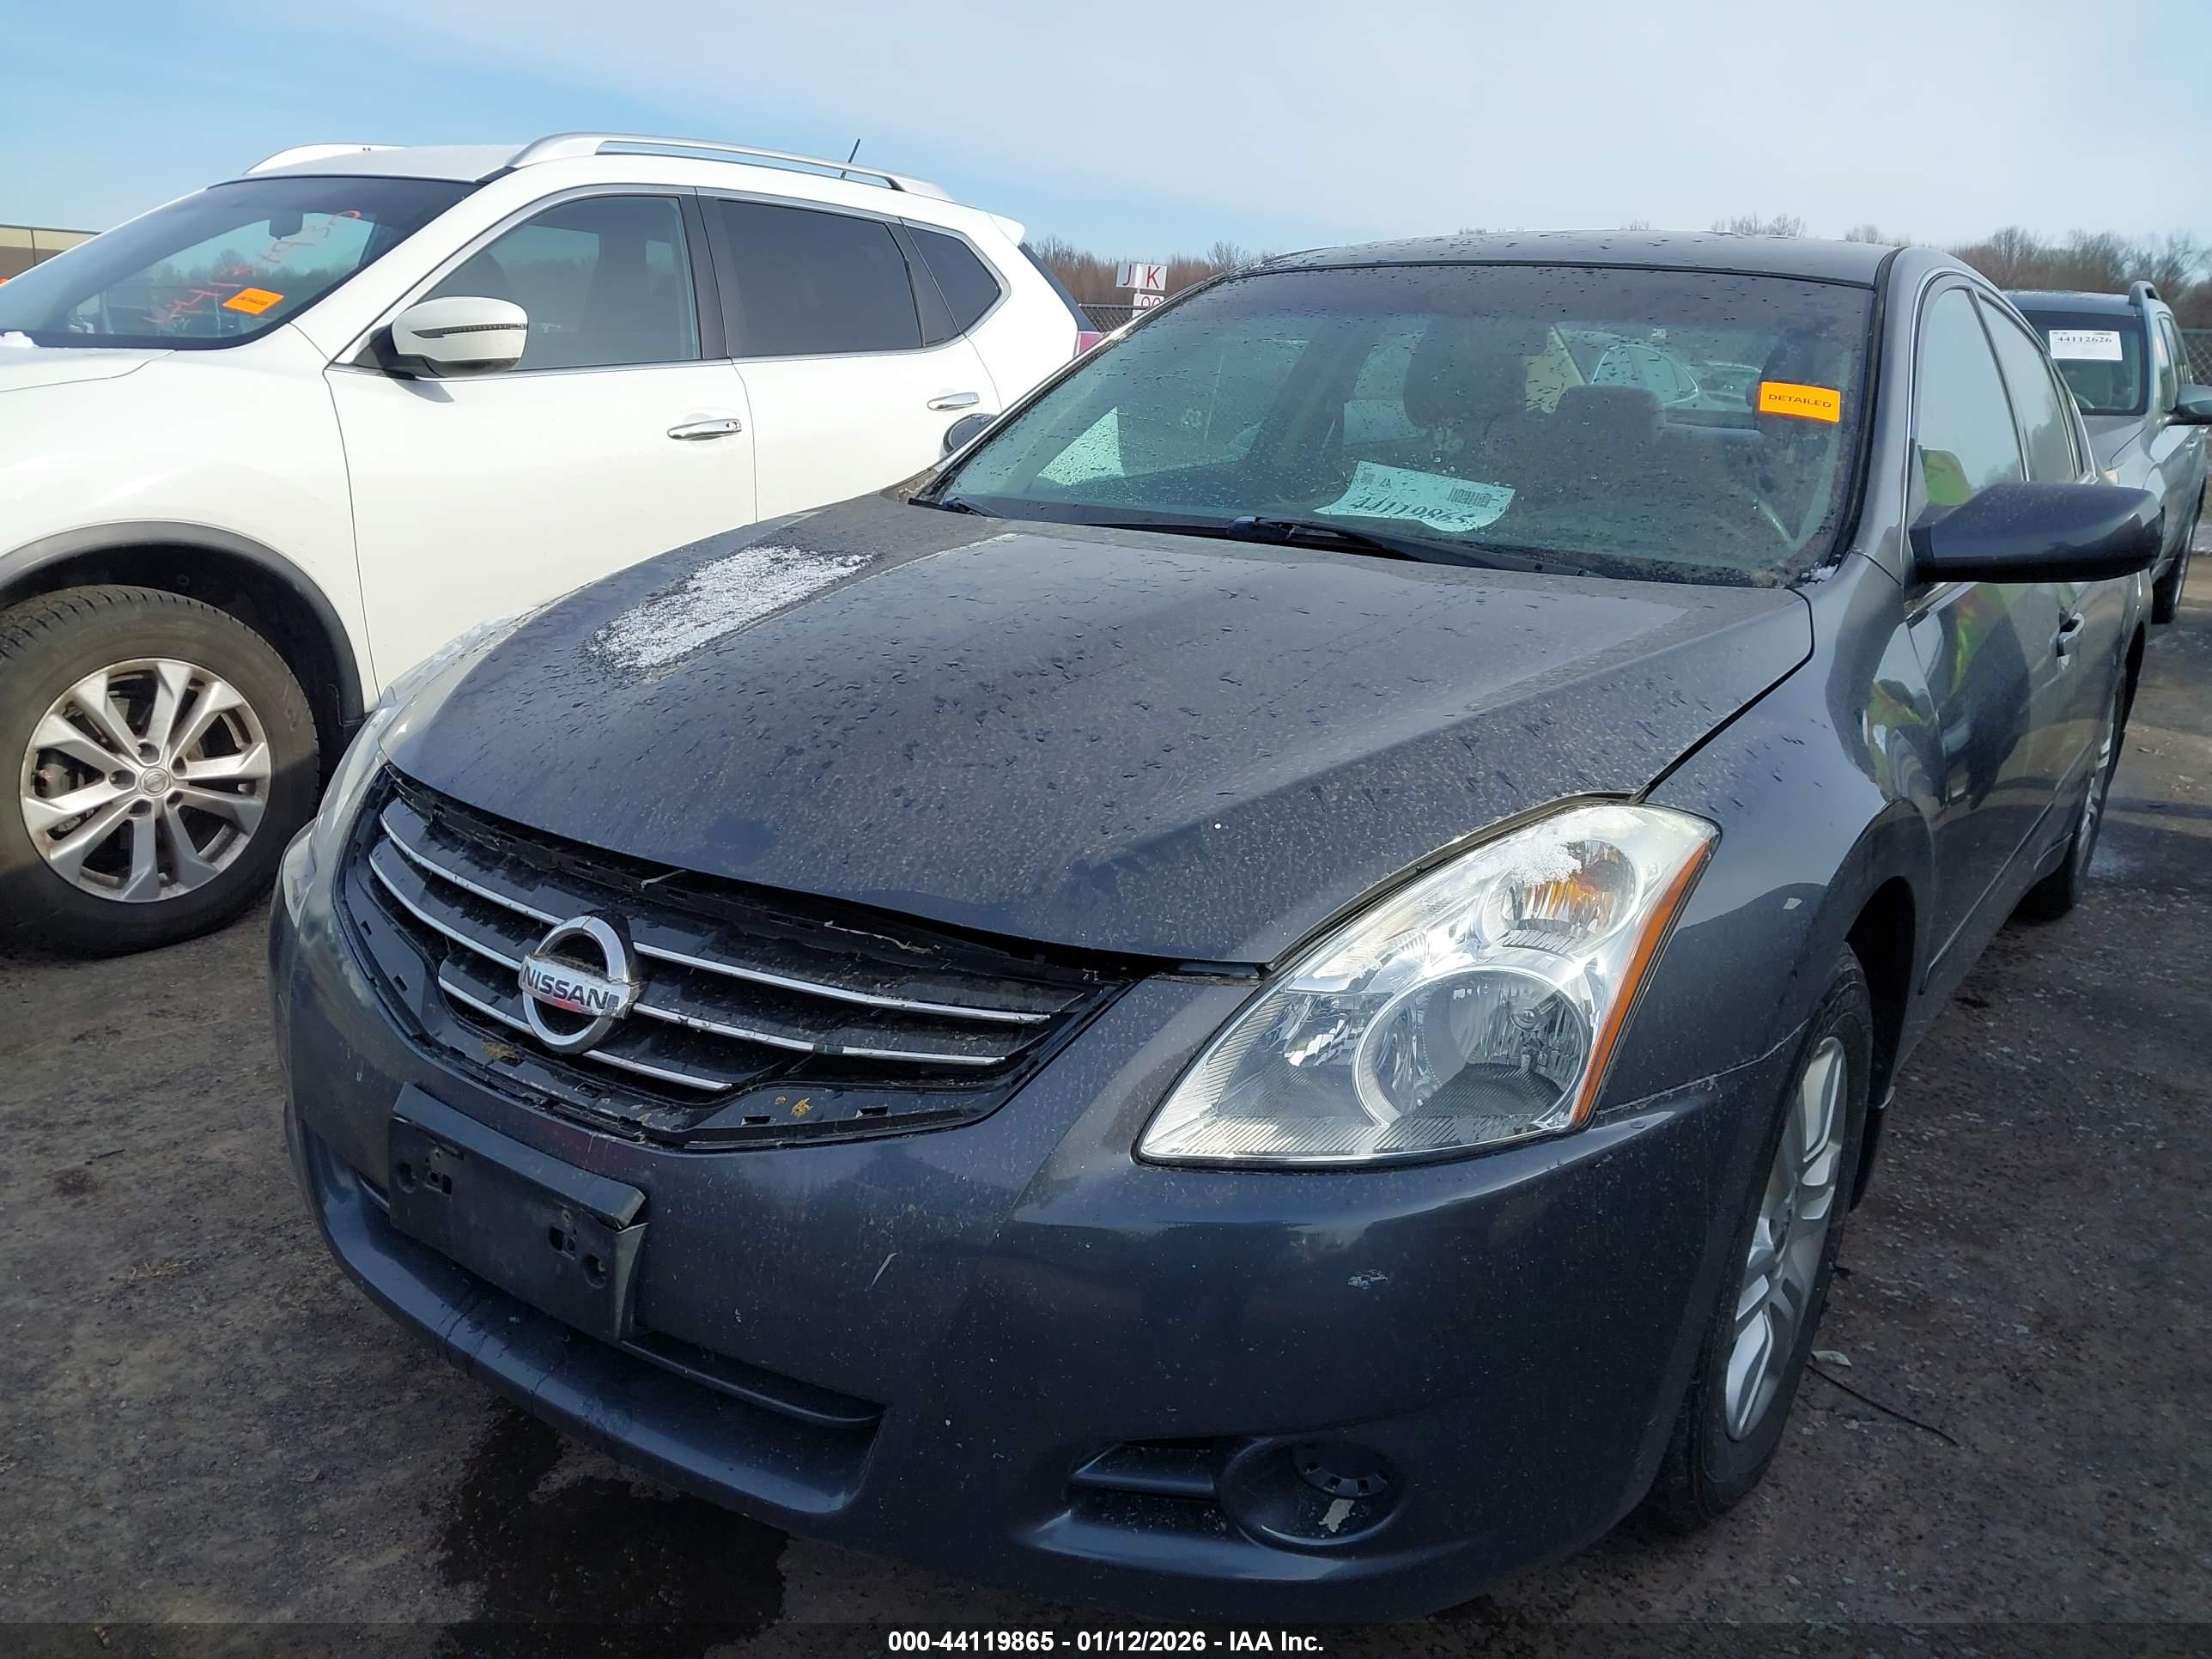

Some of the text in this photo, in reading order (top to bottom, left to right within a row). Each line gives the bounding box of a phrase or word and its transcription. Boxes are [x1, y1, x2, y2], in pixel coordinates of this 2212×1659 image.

[1122, 264, 1161, 289] J K
[1768, 393, 1832, 408] DETAILED
[522, 965, 609, 1010] NISSAN
